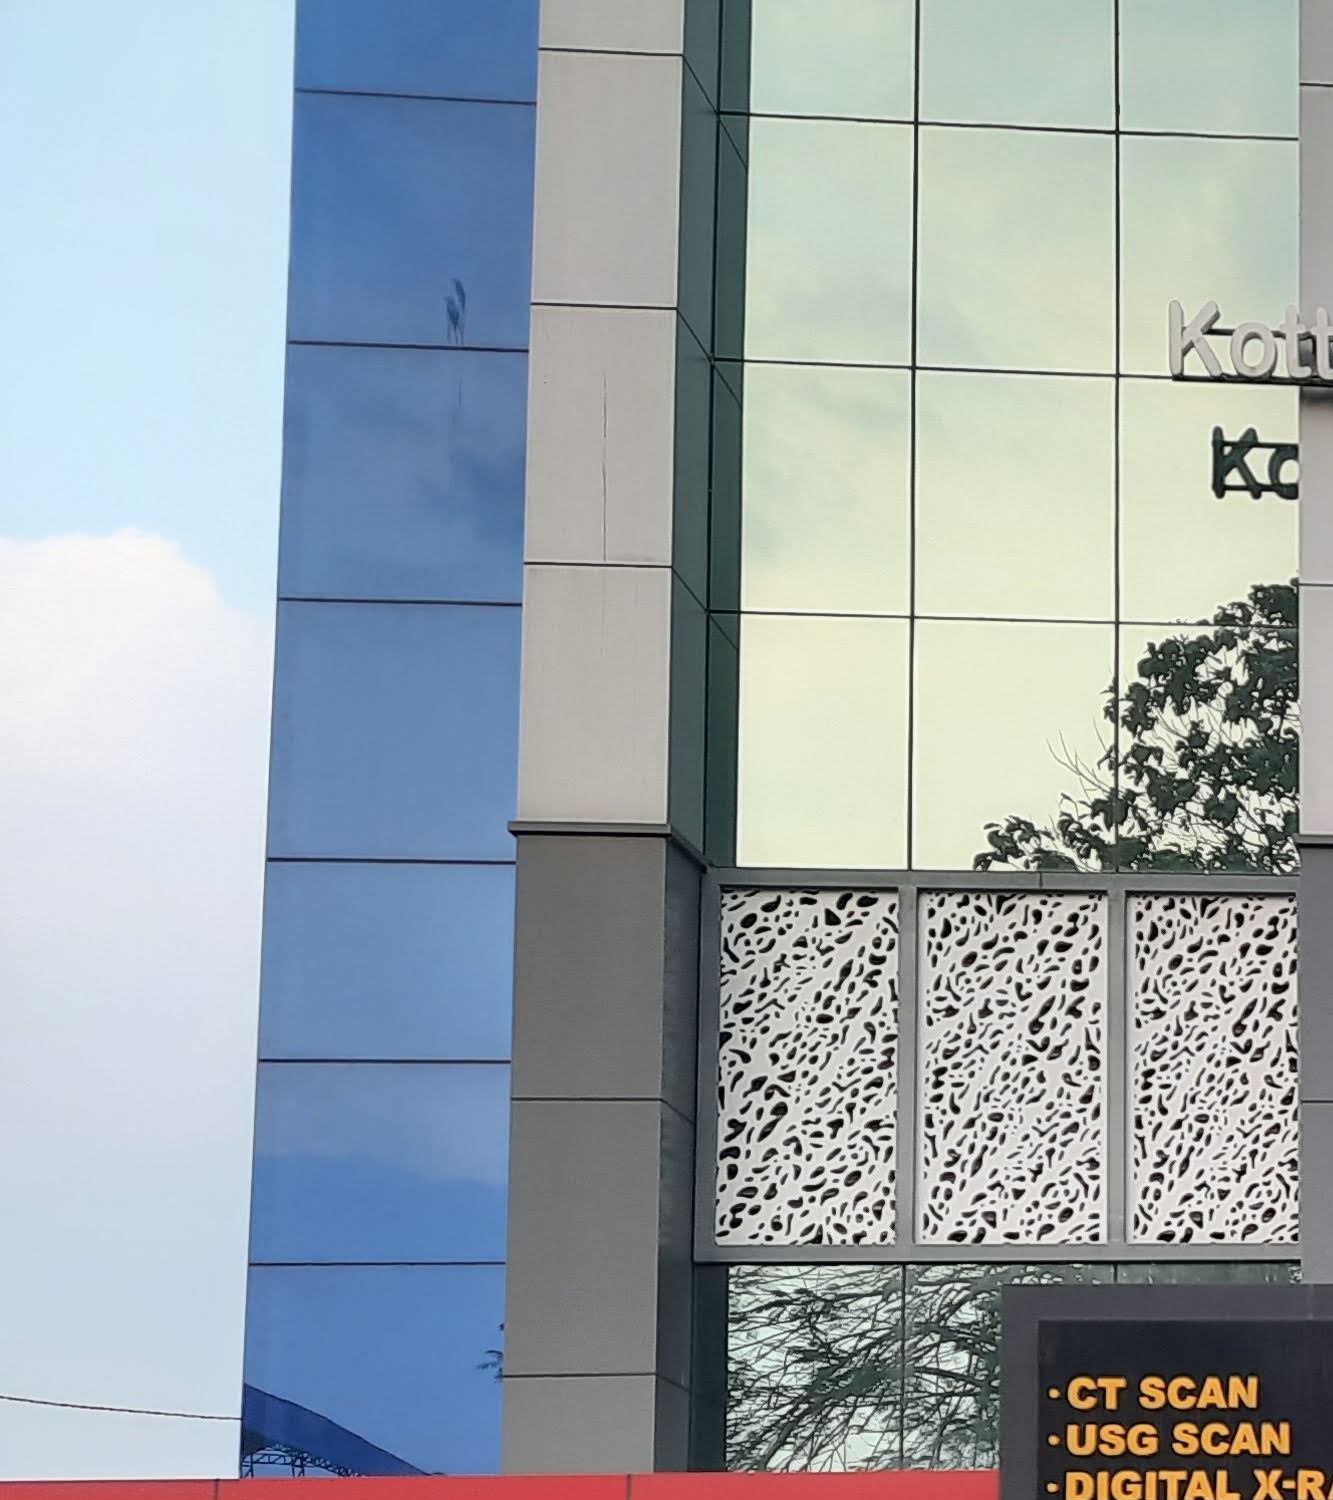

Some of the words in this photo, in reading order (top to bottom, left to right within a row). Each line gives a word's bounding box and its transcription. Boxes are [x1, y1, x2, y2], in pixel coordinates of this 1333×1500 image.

[1066, 1377, 1126, 1410] CT
[1138, 1376, 1258, 1409] SCAN
[1066, 1423, 1158, 1456] USG
[1172, 1422, 1290, 1456] SCAN
